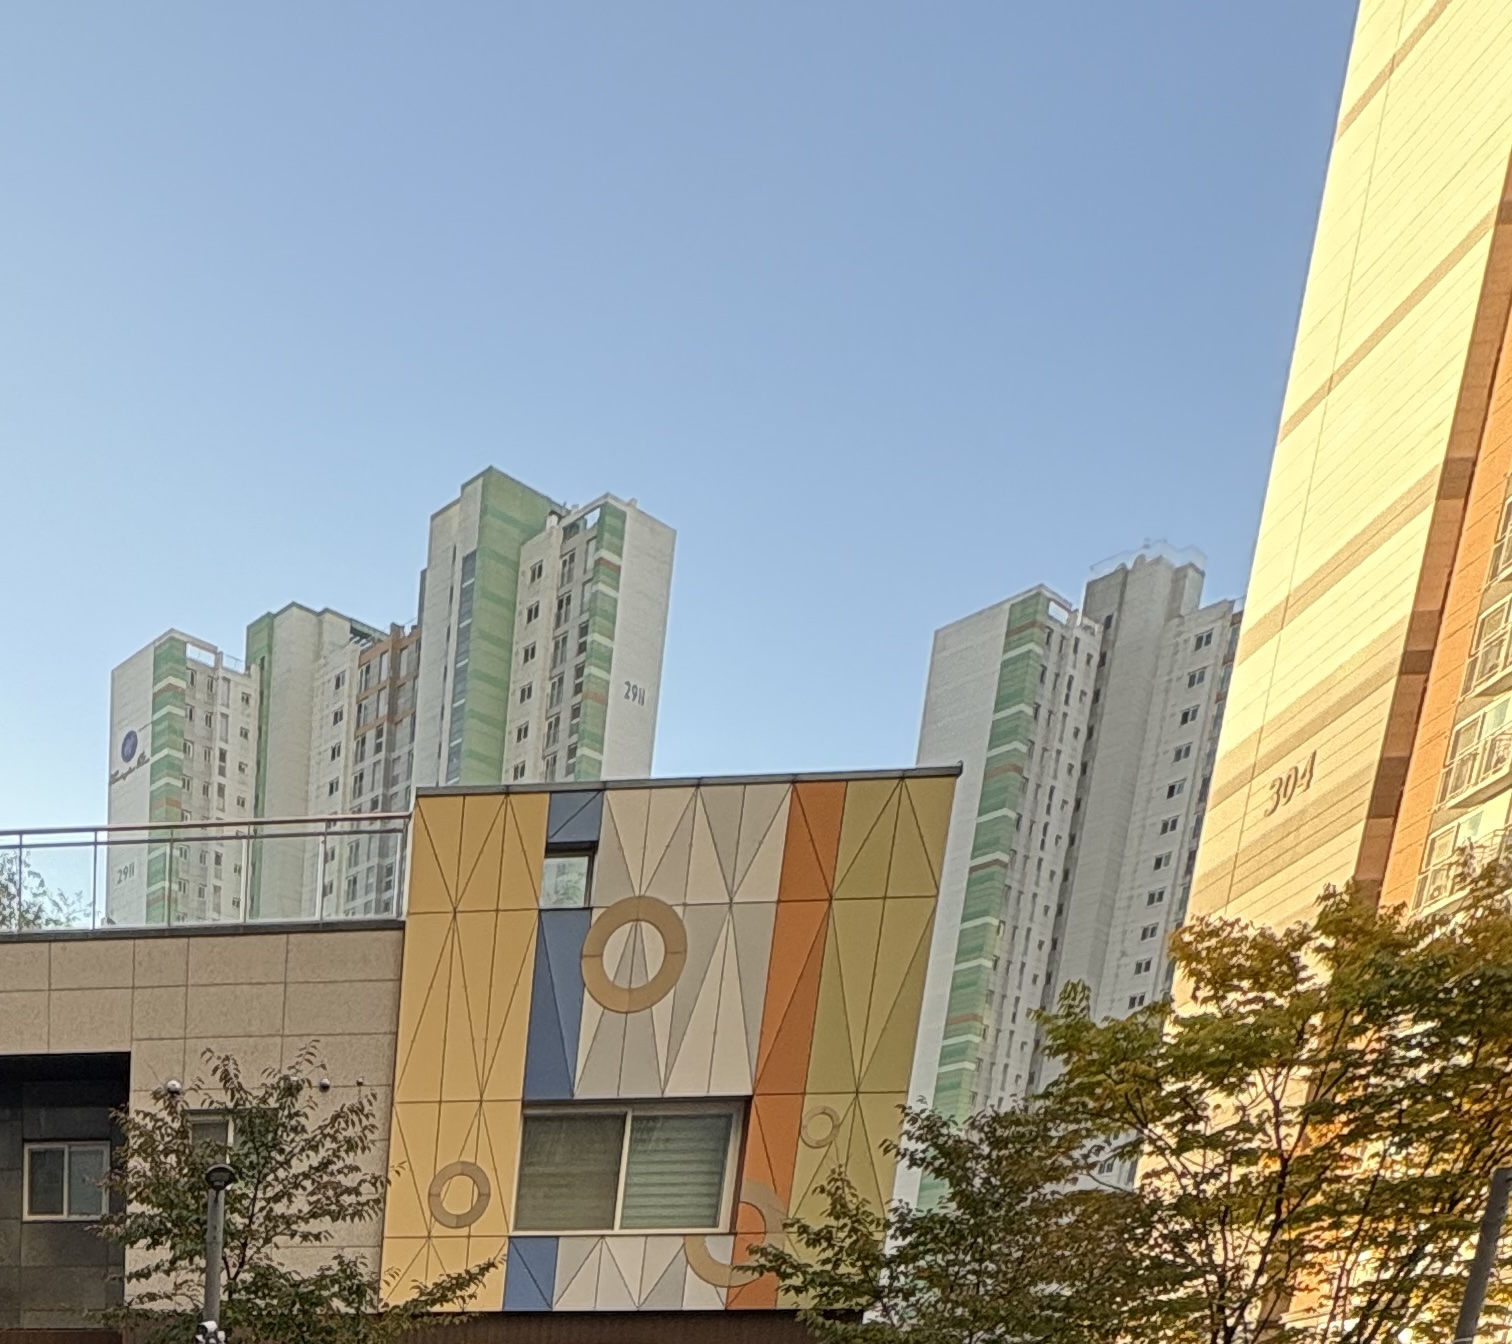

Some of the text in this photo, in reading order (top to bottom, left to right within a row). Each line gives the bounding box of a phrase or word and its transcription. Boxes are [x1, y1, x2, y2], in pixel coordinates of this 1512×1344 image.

[624, 680, 646, 707] 2911
[1264, 749, 1317, 818] 304
[116, 861, 136, 886] 2911
